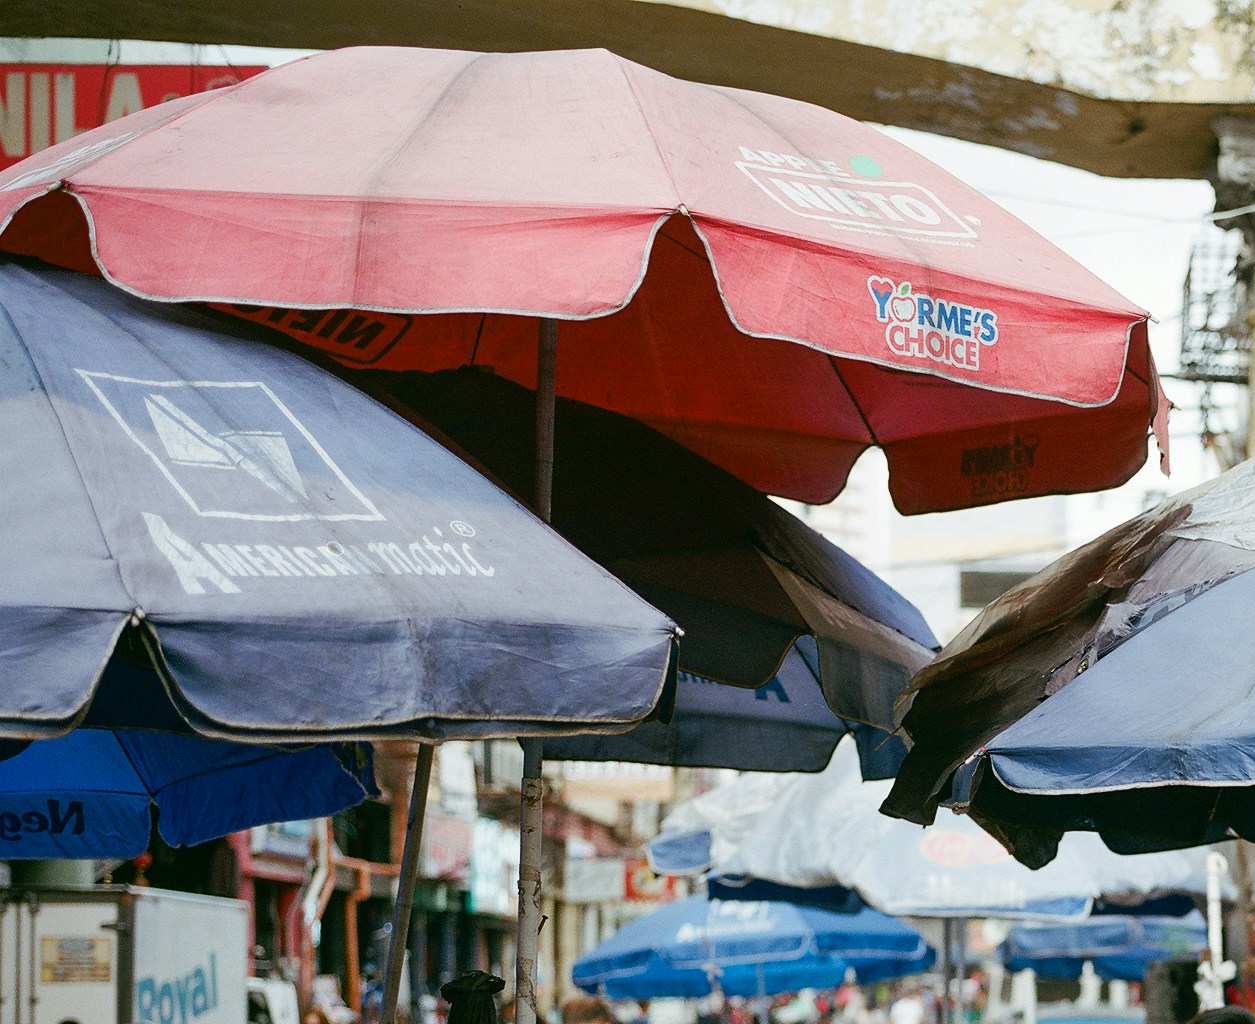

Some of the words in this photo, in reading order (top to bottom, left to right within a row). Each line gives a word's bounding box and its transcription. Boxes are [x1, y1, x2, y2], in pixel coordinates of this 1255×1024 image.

[739, 146, 851, 177] APPLE
[769, 177, 941, 225] NIETO
[870, 278, 996, 342] YORME'S
[889, 325, 978, 367] CHOICE
[141, 512, 385, 594] AMERICAN
[368, 527, 495, 577] matic
